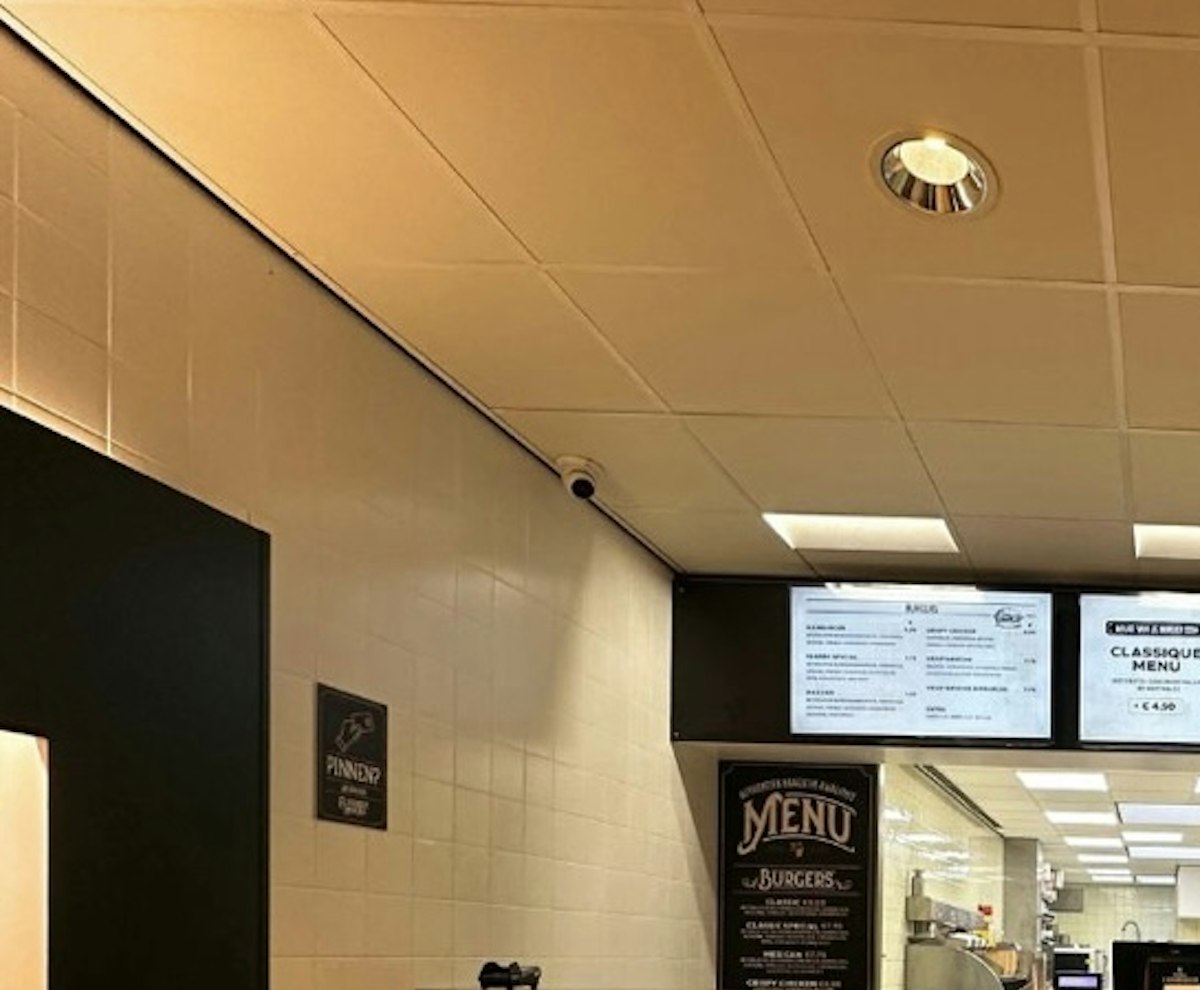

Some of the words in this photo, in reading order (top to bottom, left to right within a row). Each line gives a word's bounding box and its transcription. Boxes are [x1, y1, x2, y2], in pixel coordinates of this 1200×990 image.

[1132, 660, 1181, 672] MENU
[737, 791, 853, 855] MENU
[758, 868, 835, 891] BURGERS
